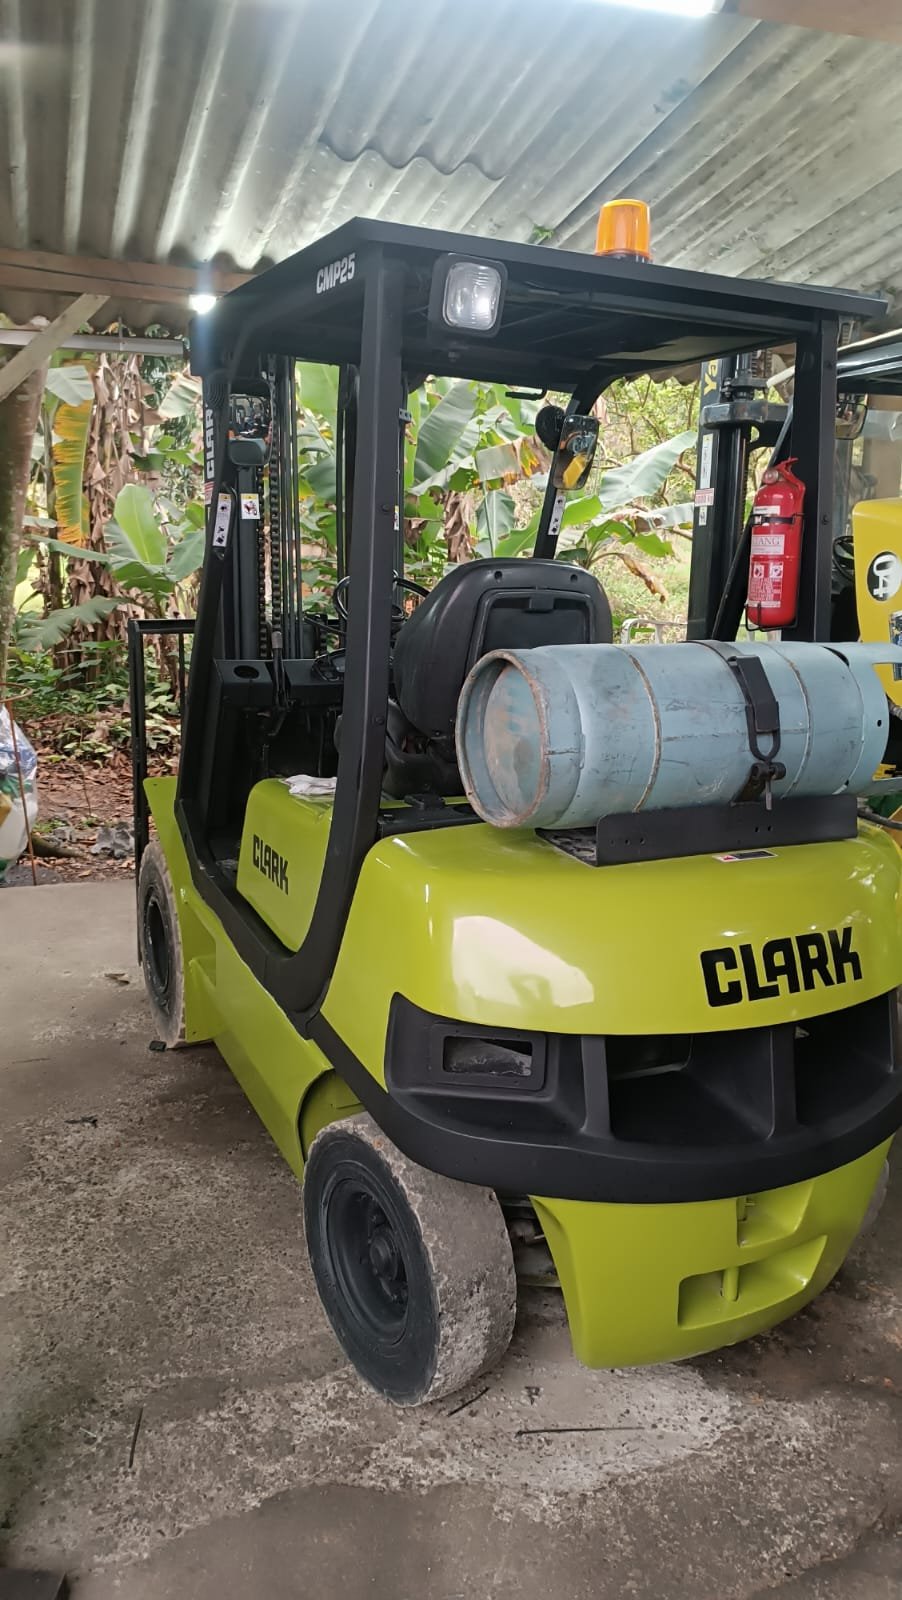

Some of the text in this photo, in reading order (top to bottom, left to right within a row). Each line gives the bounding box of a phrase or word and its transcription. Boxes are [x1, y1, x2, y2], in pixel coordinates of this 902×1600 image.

[316, 253, 356, 294] CMP25
[205, 404, 215, 479] CLAR
[253, 834, 289, 896] CLARK
[700, 927, 863, 1008] CLARK
